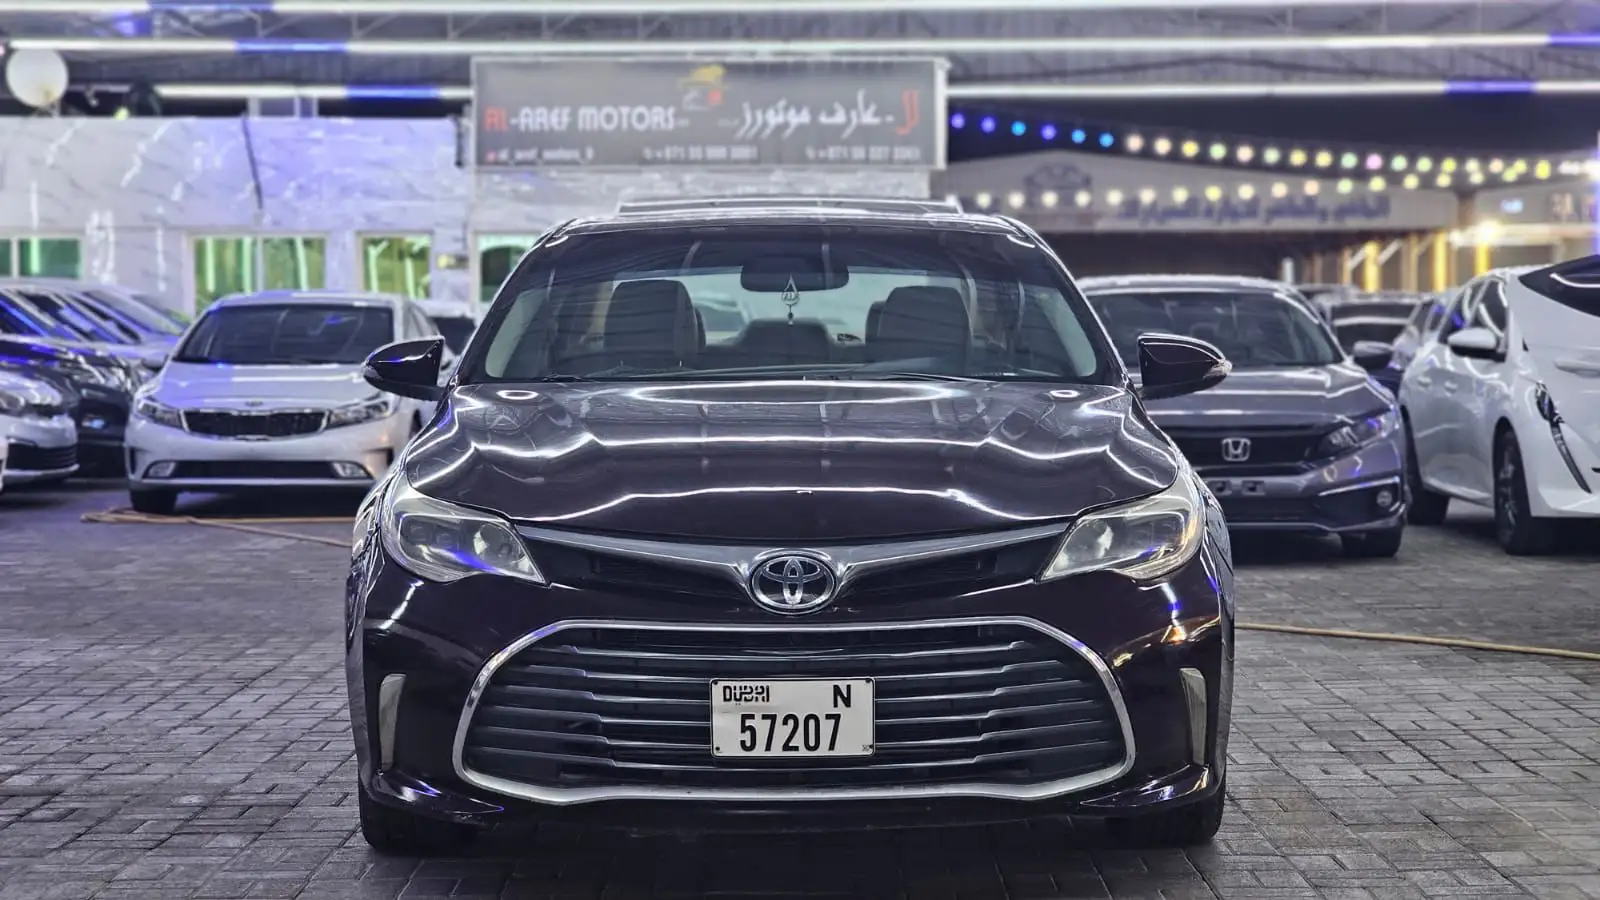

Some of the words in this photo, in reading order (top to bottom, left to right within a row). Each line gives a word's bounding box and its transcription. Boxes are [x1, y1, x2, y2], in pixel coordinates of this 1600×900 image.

[578, 106, 676, 131] MOTORS
[832, 684, 852, 708] N
[739, 713, 842, 753] 57207
